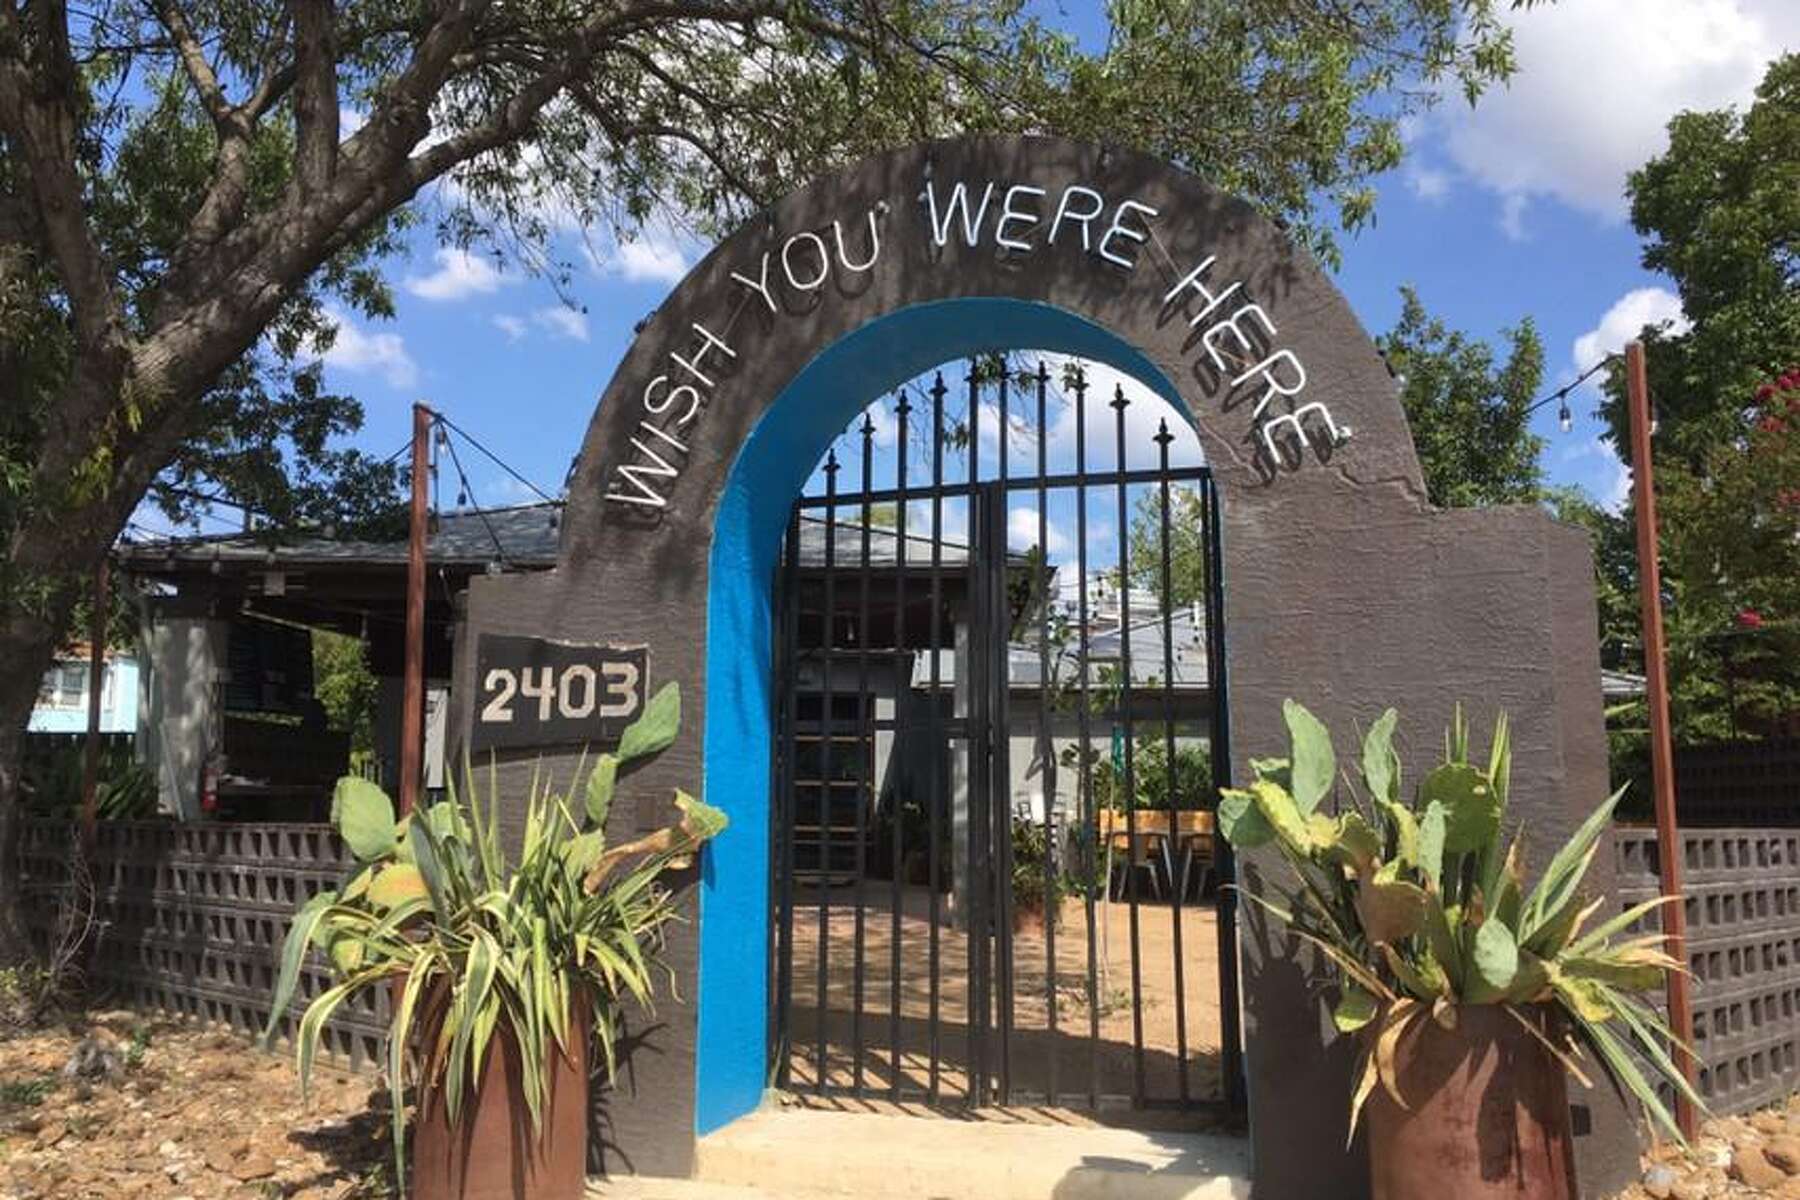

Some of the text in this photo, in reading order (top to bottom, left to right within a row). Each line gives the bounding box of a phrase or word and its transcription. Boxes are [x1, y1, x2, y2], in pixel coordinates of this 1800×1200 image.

[604, 180, 1341, 507] WISH YOU WERE HERE
[481, 661, 639, 722] 2403
